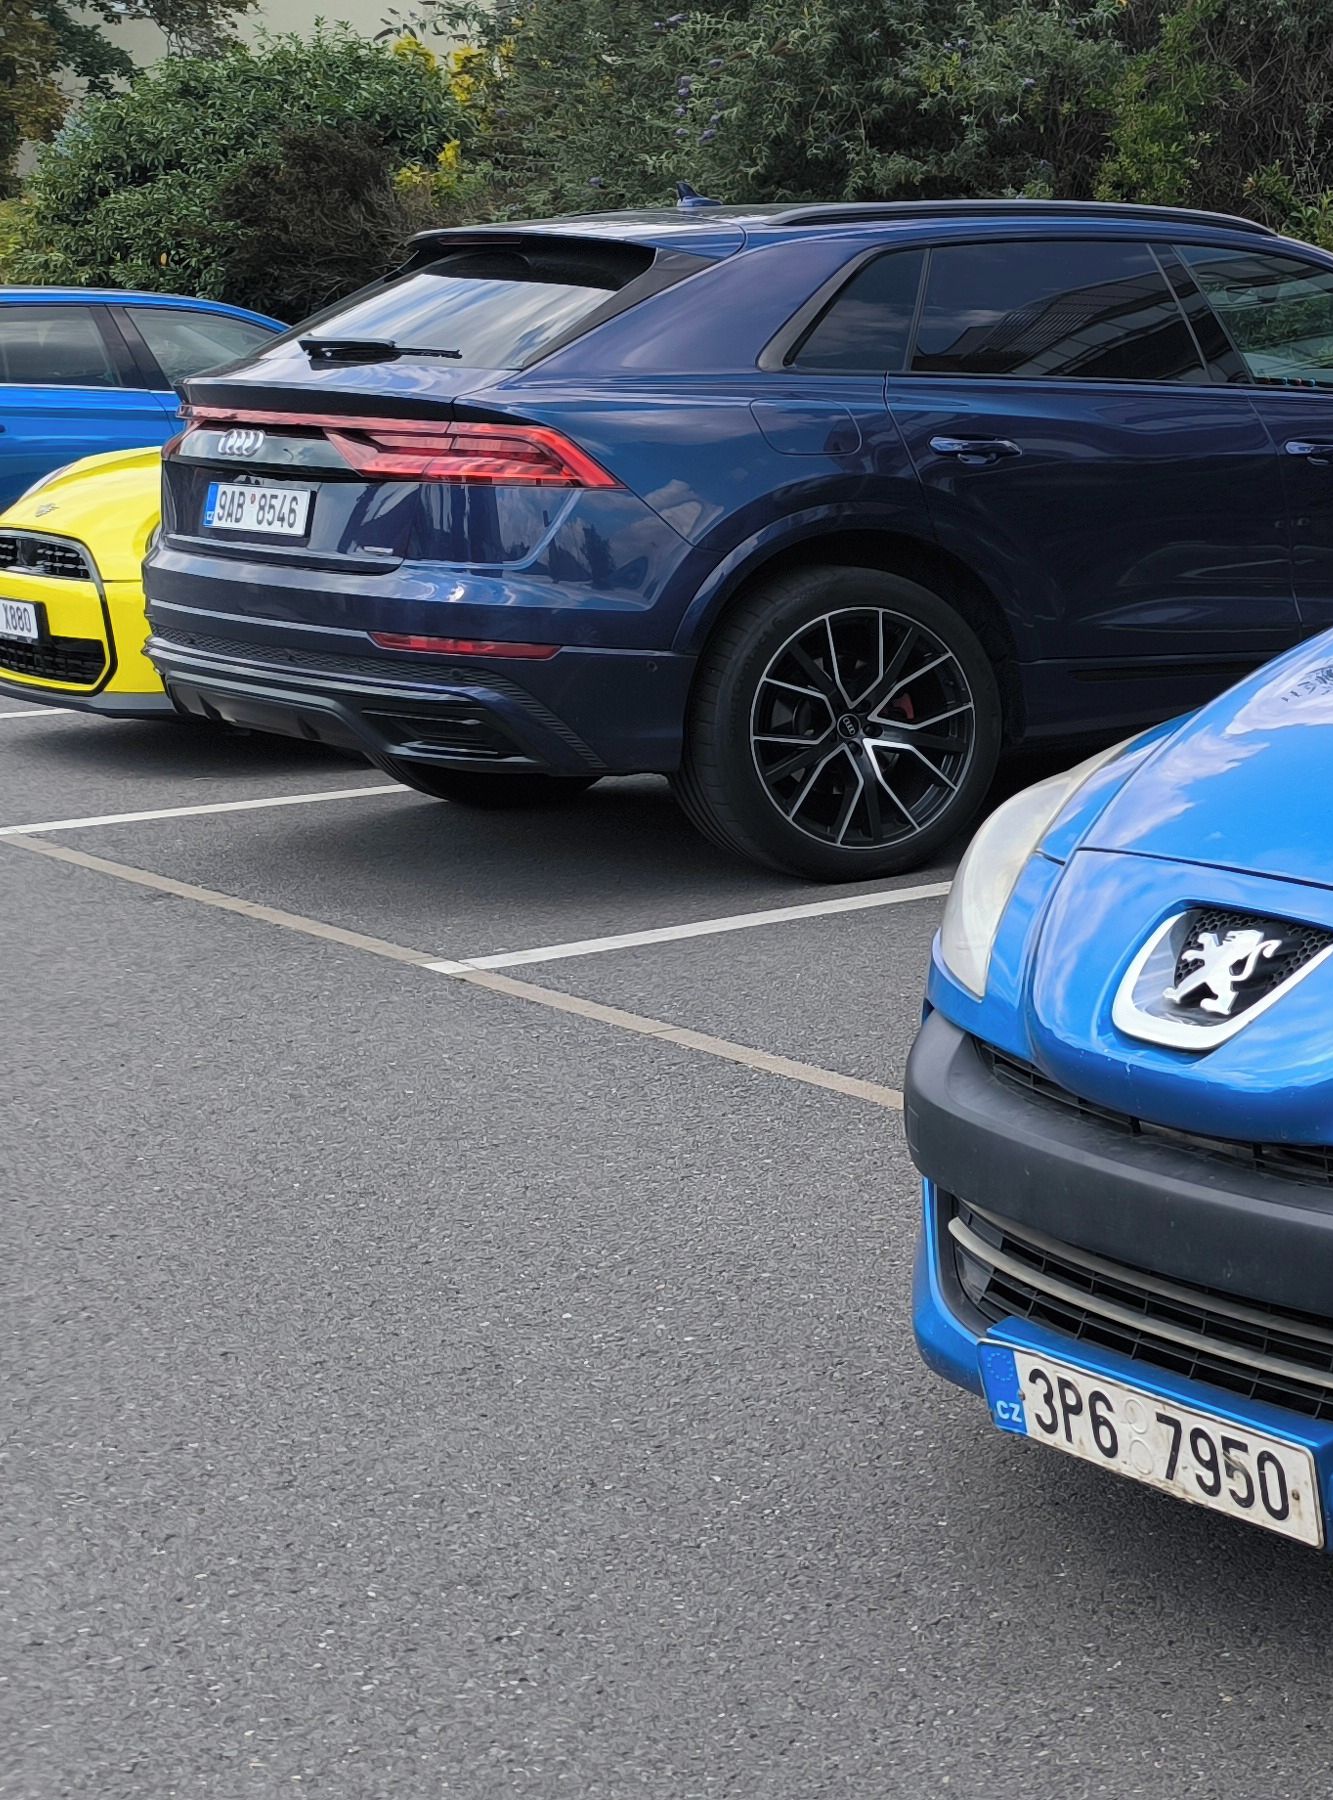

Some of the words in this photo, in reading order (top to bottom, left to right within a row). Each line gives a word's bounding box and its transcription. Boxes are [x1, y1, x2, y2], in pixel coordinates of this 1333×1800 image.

[217, 490, 246, 523] 9AB
[256, 493, 298, 528] 8546
[996, 1401, 1024, 1424] CZ
[1028, 1368, 1119, 1459] 3P6
[1156, 1411, 1290, 1521] 7950
